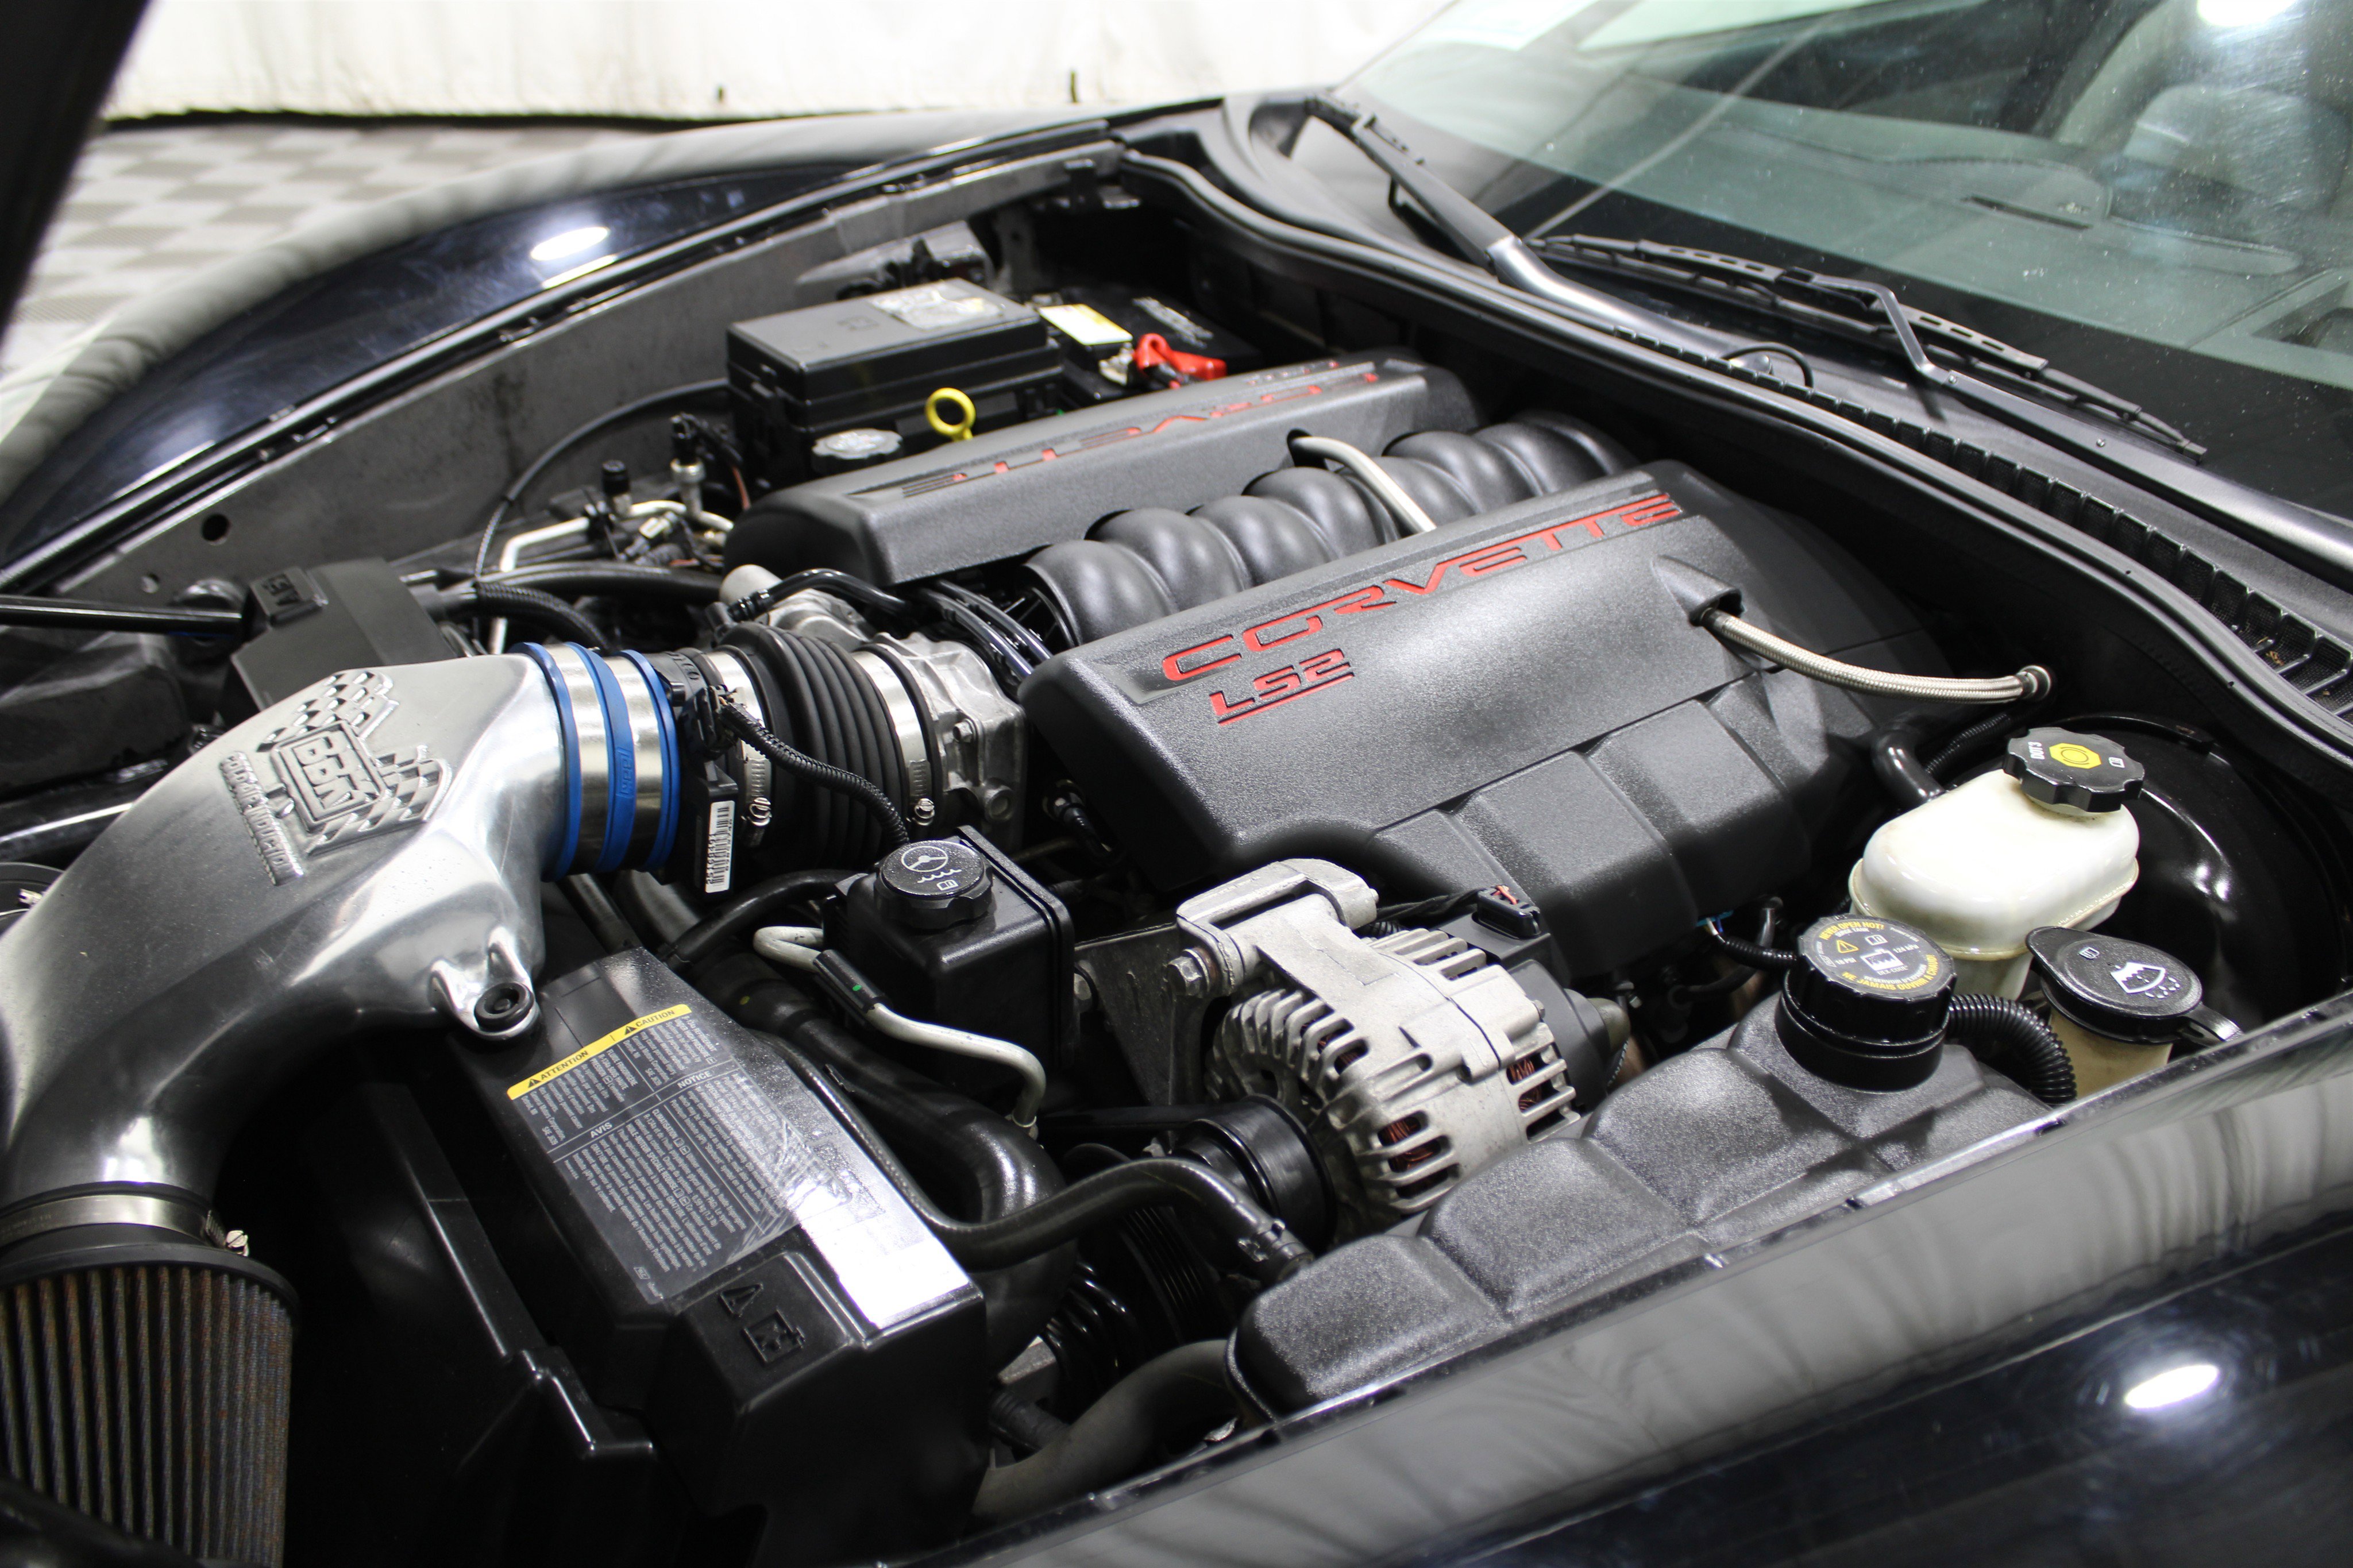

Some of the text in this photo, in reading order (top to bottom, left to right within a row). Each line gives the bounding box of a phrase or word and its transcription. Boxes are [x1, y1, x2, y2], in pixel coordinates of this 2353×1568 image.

[1161, 493, 1683, 682] CORVETTE
[1209, 648, 1351, 718] LS2
[2029, 746, 2045, 759] DOT
[1819, 921, 1885, 940] NEVER OPEN HOT!
[1842, 971, 1857, 981] NE
[1857, 979, 1897, 990] JAMAIS
[1897, 978, 1930, 990] OUVRIR
[635, 1010, 675, 1028] CAUTION
[541, 1051, 588, 1080] ATTENTION
[677, 1071, 712, 1089] NOTICE
[590, 1123, 613, 1138] AVIS
